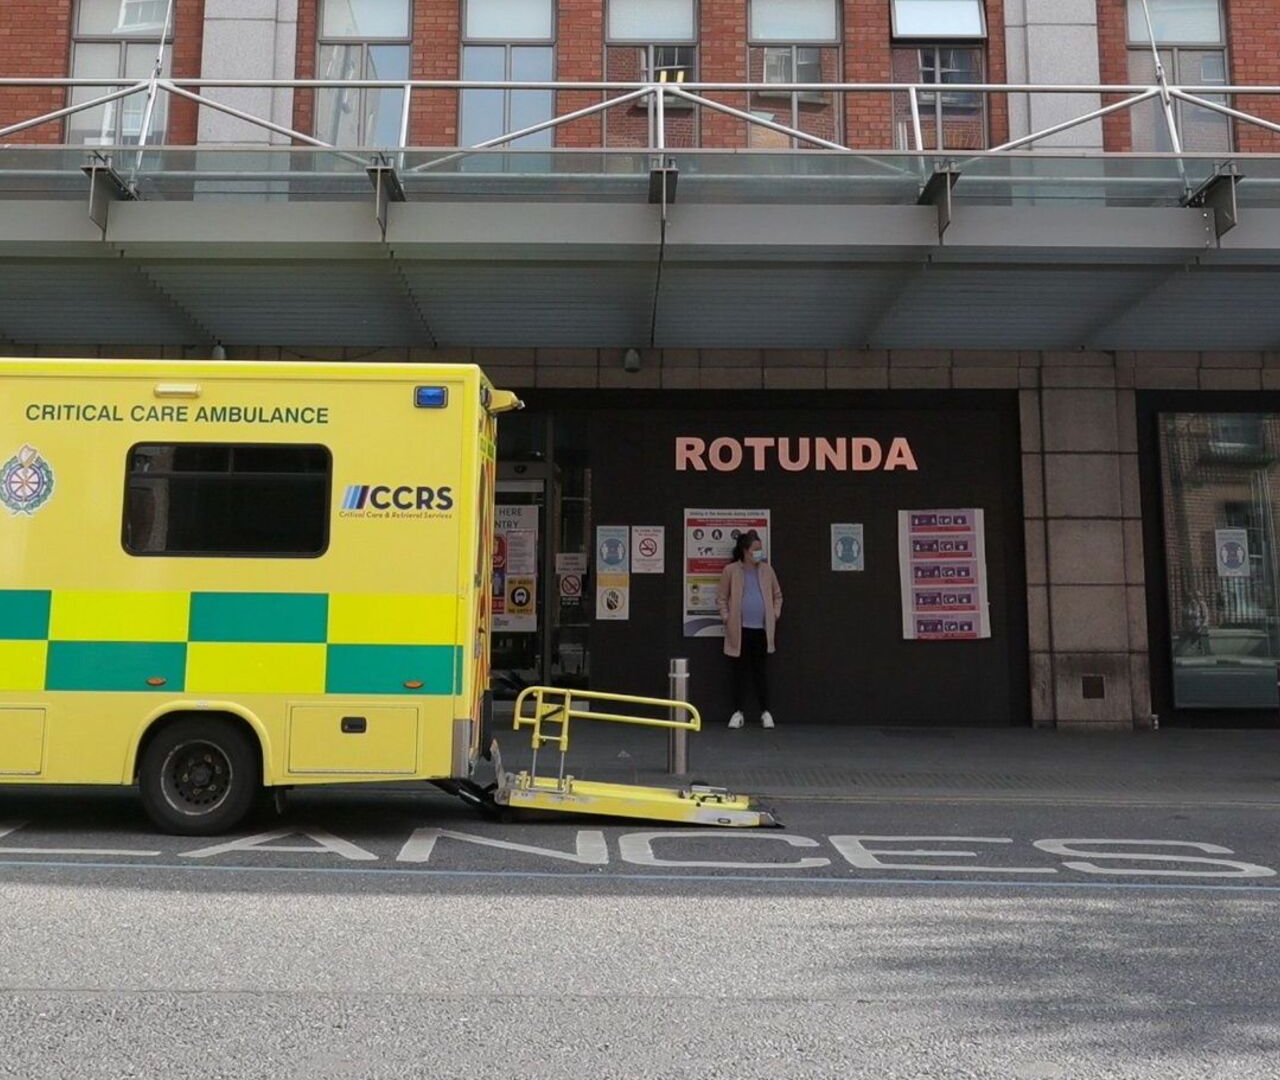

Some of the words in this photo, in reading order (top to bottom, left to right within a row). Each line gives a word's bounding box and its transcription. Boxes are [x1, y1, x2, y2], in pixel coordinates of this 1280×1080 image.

[25, 404, 124, 422] CRITICAL
[129, 404, 188, 423] CARE
[194, 406, 329, 424] AMBULANCE
[674, 436, 918, 472] ROTUNDA
[370, 486, 453, 510] CCRS
[366, 511, 383, 519] Care
[499, 507, 522, 517] HERE
[494, 519, 519, 529] NTRY
